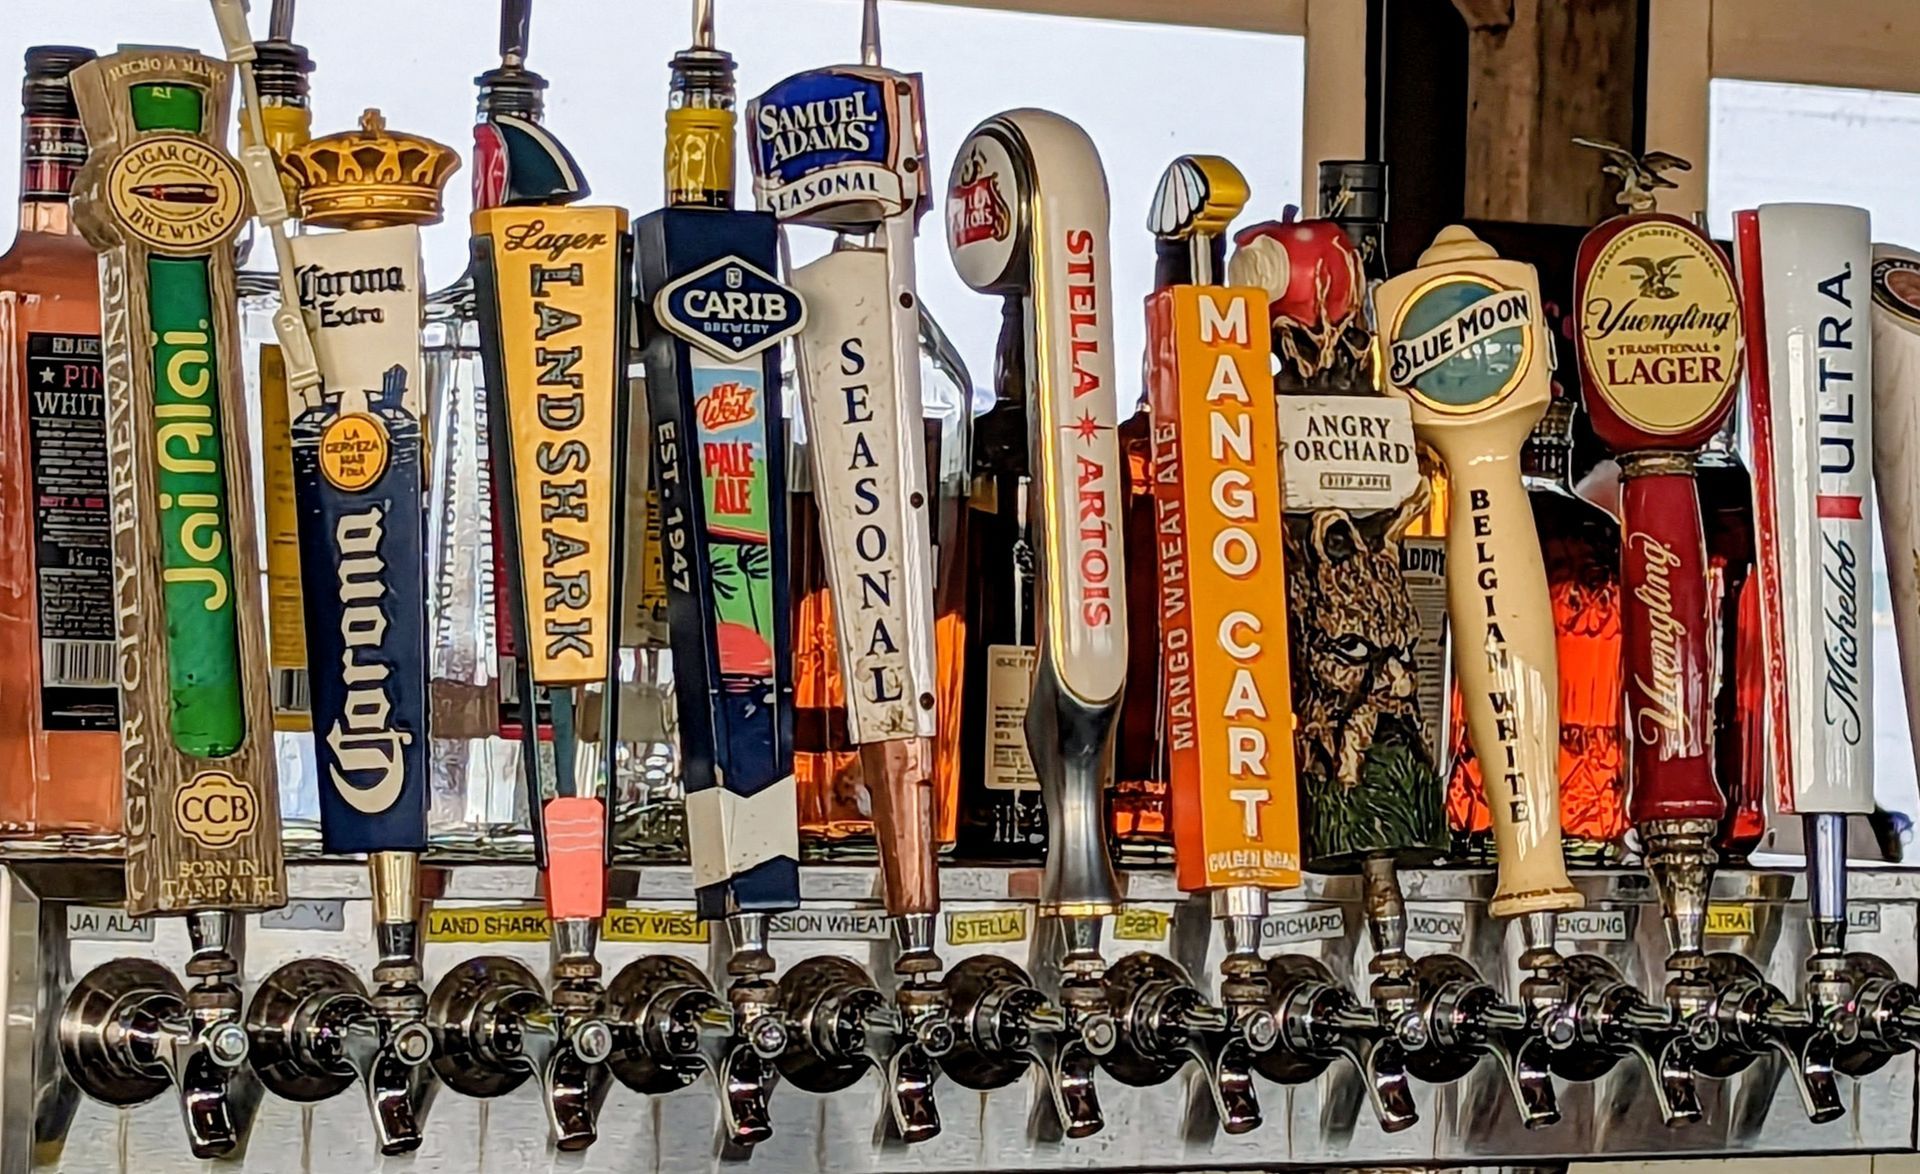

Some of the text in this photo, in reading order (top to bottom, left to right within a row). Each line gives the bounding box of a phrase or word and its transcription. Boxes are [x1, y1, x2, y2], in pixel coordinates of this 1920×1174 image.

[760, 91, 876, 140] SAMUEL
[770, 121, 870, 168] ADAMS
[125, 144, 184, 178] CIGAR
[183, 145, 226, 178] CITY
[767, 172, 879, 211] SEASONAL
[129, 209, 225, 240] BREWING
[504, 220, 607, 263] Lager
[295, 264, 405, 307] Corona
[683, 290, 788, 321] CARIB
[1584, 298, 1739, 340] Yuengling
[703, 322, 769, 334] BREWERY
[1391, 294, 1529, 384] BLUE MOON
[1617, 343, 1713, 355] TRADITIONAL
[63, 365, 103, 388] PIN
[1607, 357, 1725, 385] LAGER
[34, 391, 102, 416] WHIT
[343, 429, 359, 440] LA
[1066, 229, 1113, 629] STELLA ARTOIS
[1198, 295, 1260, 571] MANGO
[1307, 415, 1390, 440] ANGRY
[530, 263, 595, 661] LANDSHARK
[704, 442, 755, 478] PALE
[1294, 440, 1410, 464] ORCHARD
[714, 479, 752, 514] ALE
[1817, 270, 1860, 746] Michelob ULTRA
[840, 337, 904, 702] SEASONAL
[667, 507, 690, 594] 1947
[102, 254, 151, 899] CIGAR CITY BREWING
[1156, 422, 1194, 750] MANGO WHEAT ALE
[1470, 489, 1508, 673] BELGIAN
[326, 507, 413, 814] Corona
[1217, 611, 1268, 843] CART
[182, 794, 248, 823] CCB
[180, 859, 259, 878] BORN IN
[70, 914, 148, 933] JAI ALAI
[429, 916, 548, 935] LAND SHARK
[611, 916, 701, 936] KEY WEST
[768, 914, 886, 933] SSION WHEAT
[957, 913, 1019, 939] STELLA
[1263, 914, 1343, 938] ORCHARD
[1411, 917, 1460, 936] MOON
[1706, 911, 1745, 929] LTRA
[1849, 911, 1878, 927] LER
